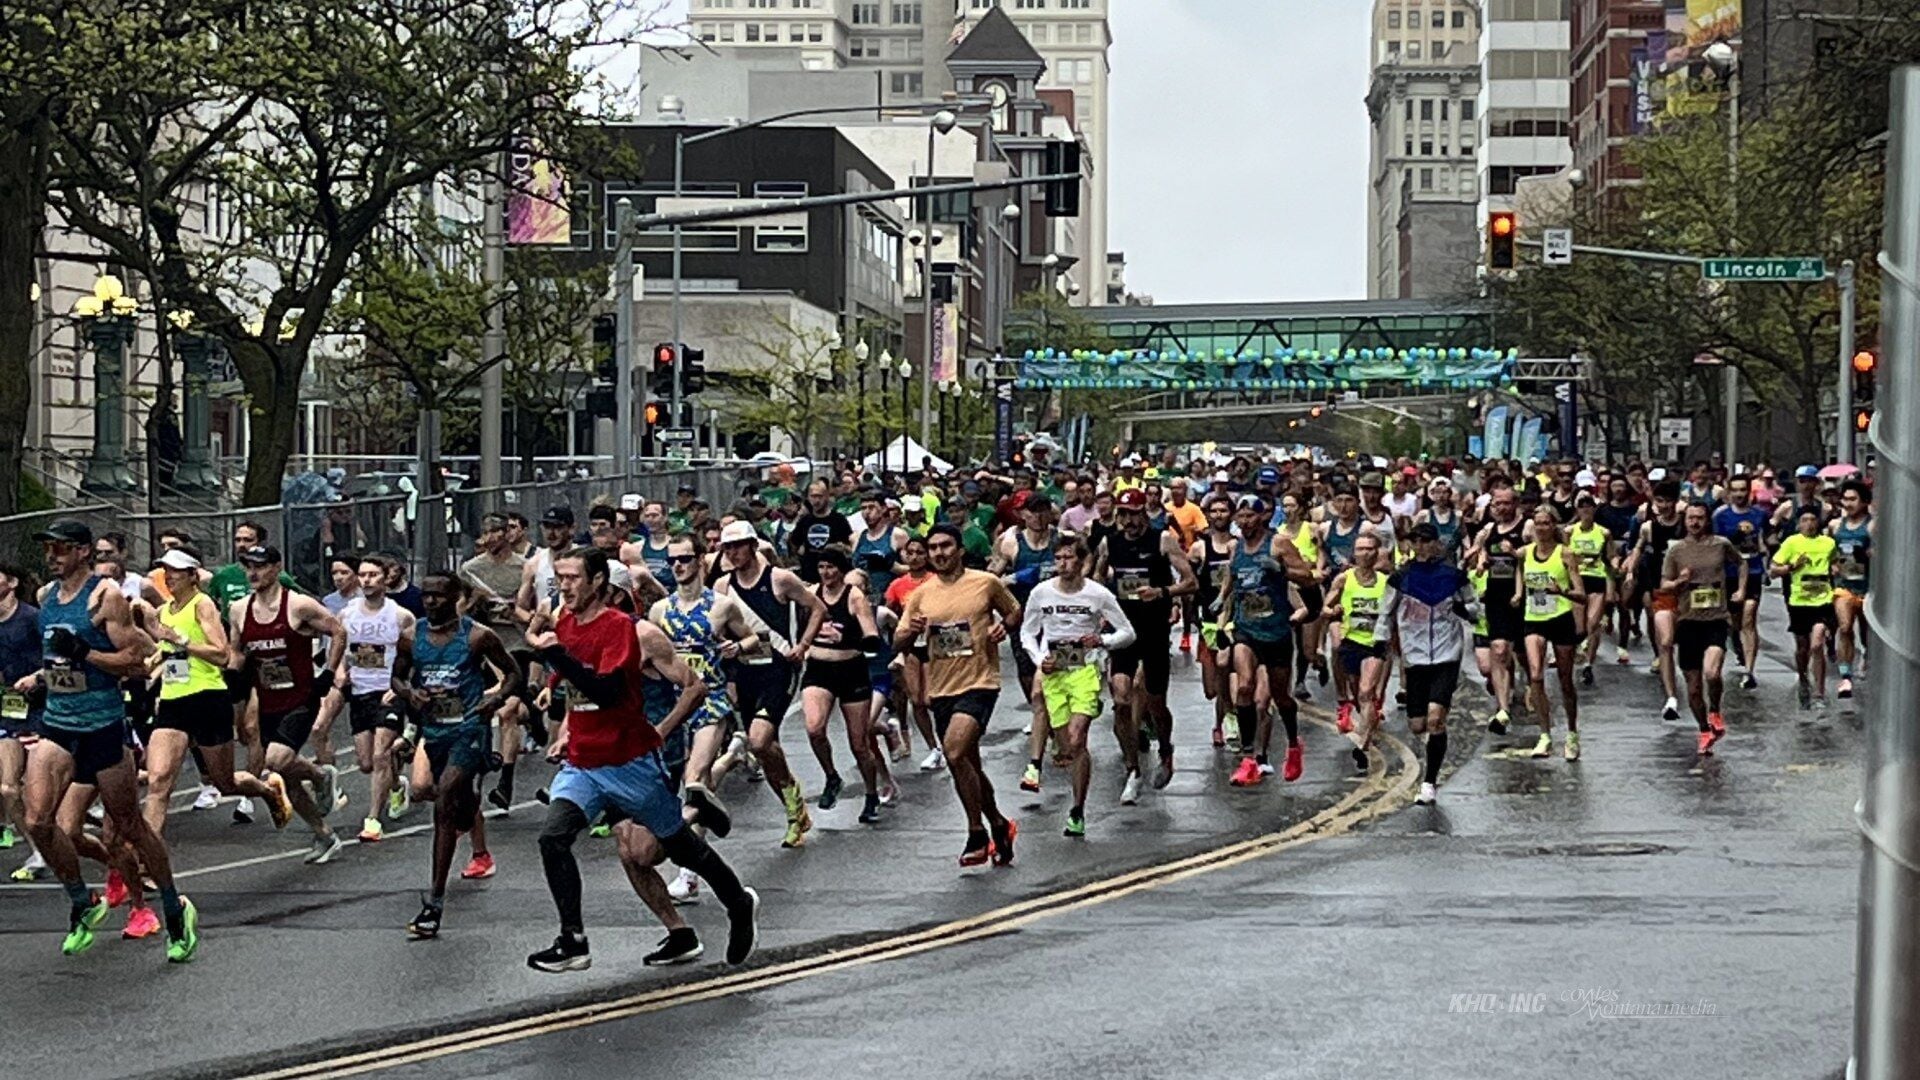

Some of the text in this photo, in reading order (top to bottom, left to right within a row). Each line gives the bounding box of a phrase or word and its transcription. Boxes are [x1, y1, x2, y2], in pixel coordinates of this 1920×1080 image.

[1710, 262, 1787, 277] Lincoln
[997, 382, 1012, 402] W
[1555, 382, 1570, 403] W
